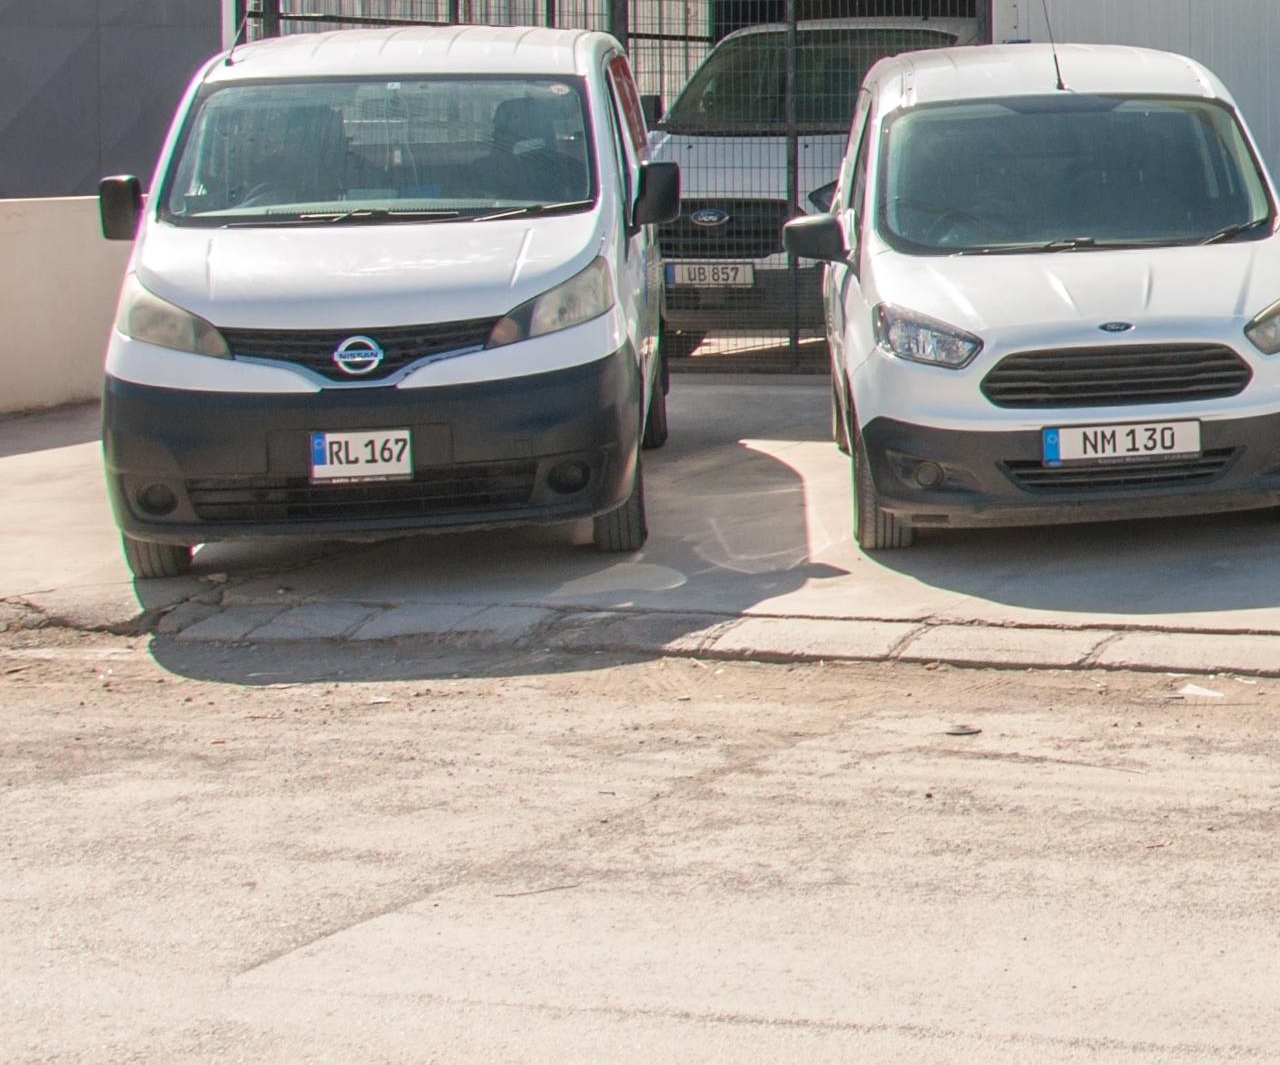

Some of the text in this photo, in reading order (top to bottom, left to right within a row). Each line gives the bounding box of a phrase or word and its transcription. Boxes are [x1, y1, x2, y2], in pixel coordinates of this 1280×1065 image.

[686, 266, 740, 283] UB 857
[338, 351, 379, 360] NISSAN
[328, 438, 409, 465] RL 167
[1082, 426, 1176, 455] NM 130
